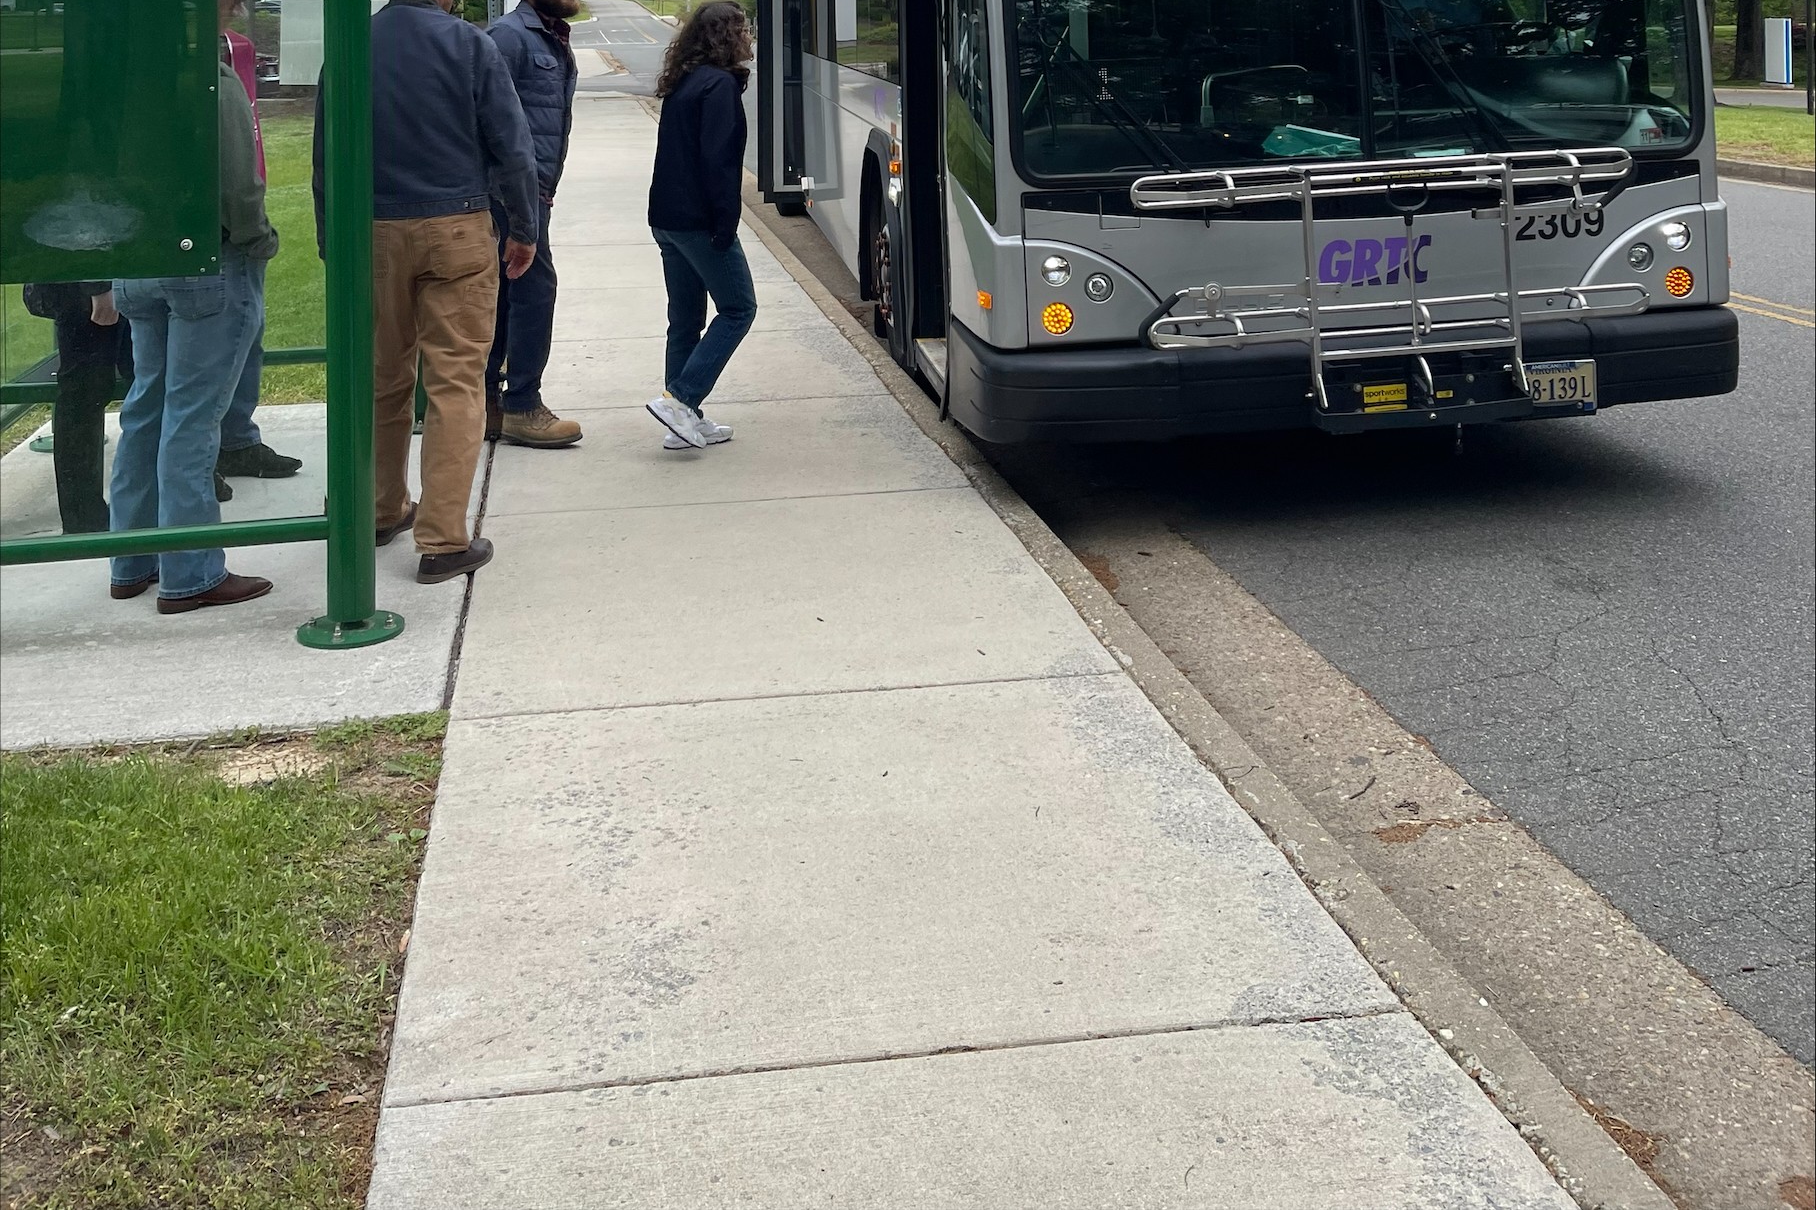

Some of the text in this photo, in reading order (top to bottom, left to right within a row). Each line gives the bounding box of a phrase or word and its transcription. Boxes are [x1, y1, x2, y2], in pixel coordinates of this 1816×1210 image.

[1514, 208, 1605, 242] 2309
[1318, 234, 1432, 288] GRTC
[1364, 388, 1405, 399] sportworks
